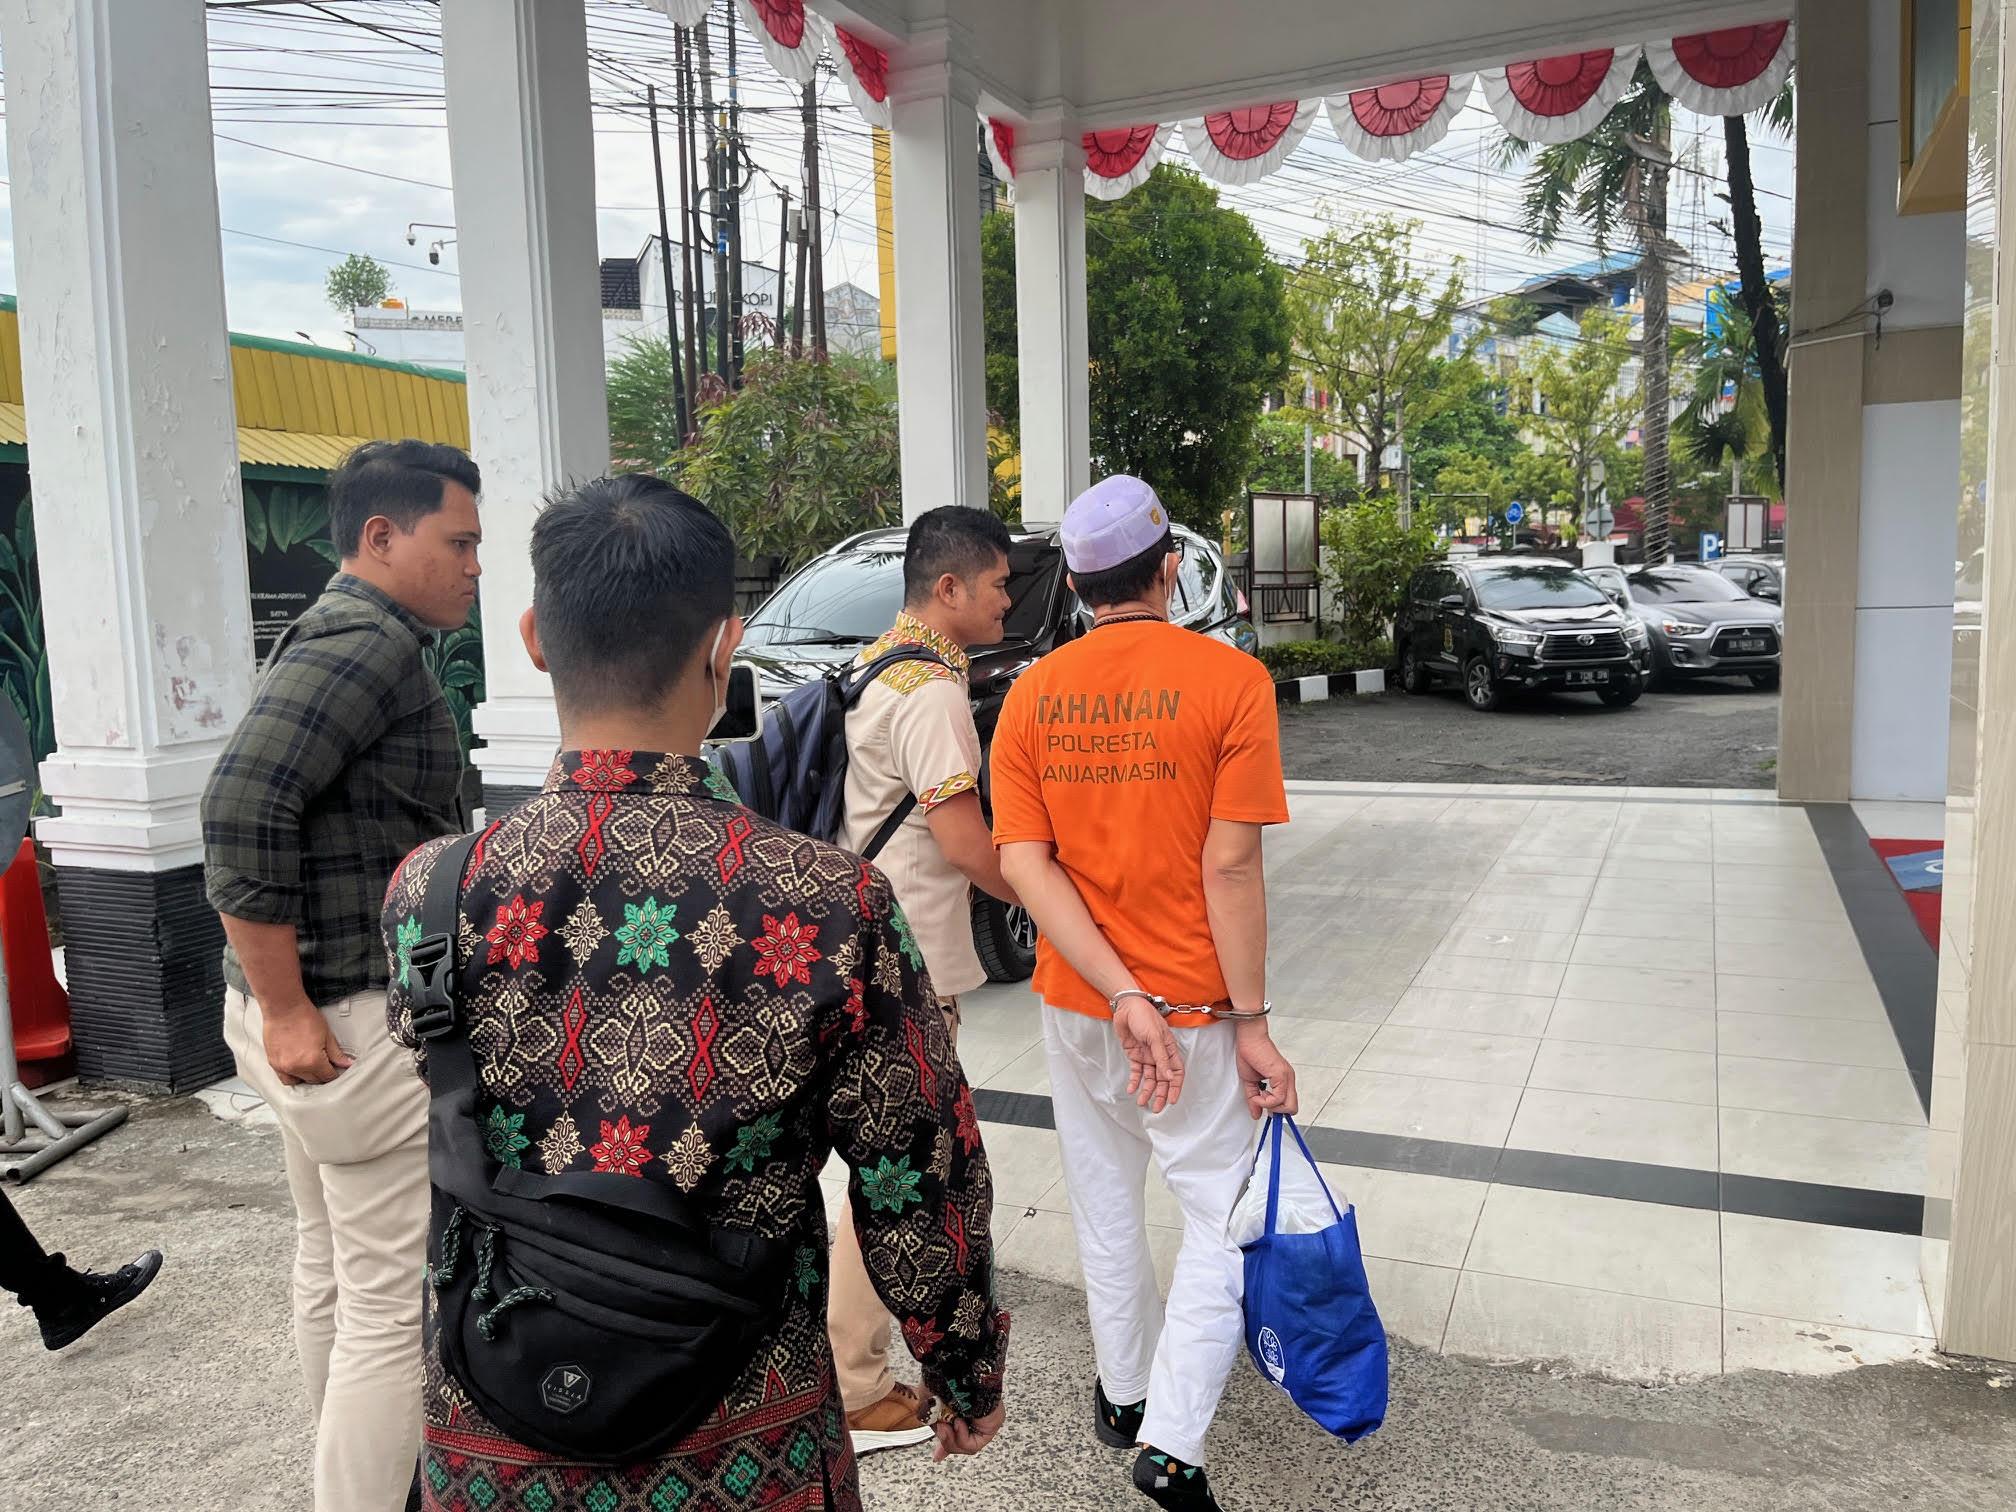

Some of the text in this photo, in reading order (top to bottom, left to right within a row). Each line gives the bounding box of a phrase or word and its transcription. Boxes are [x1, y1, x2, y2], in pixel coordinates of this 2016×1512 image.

[740, 292, 773, 306] KOPI
[1703, 533, 1718, 561] P
[1037, 689, 1181, 724] TAHANAN
[1047, 731, 1157, 754] POLRESTA
